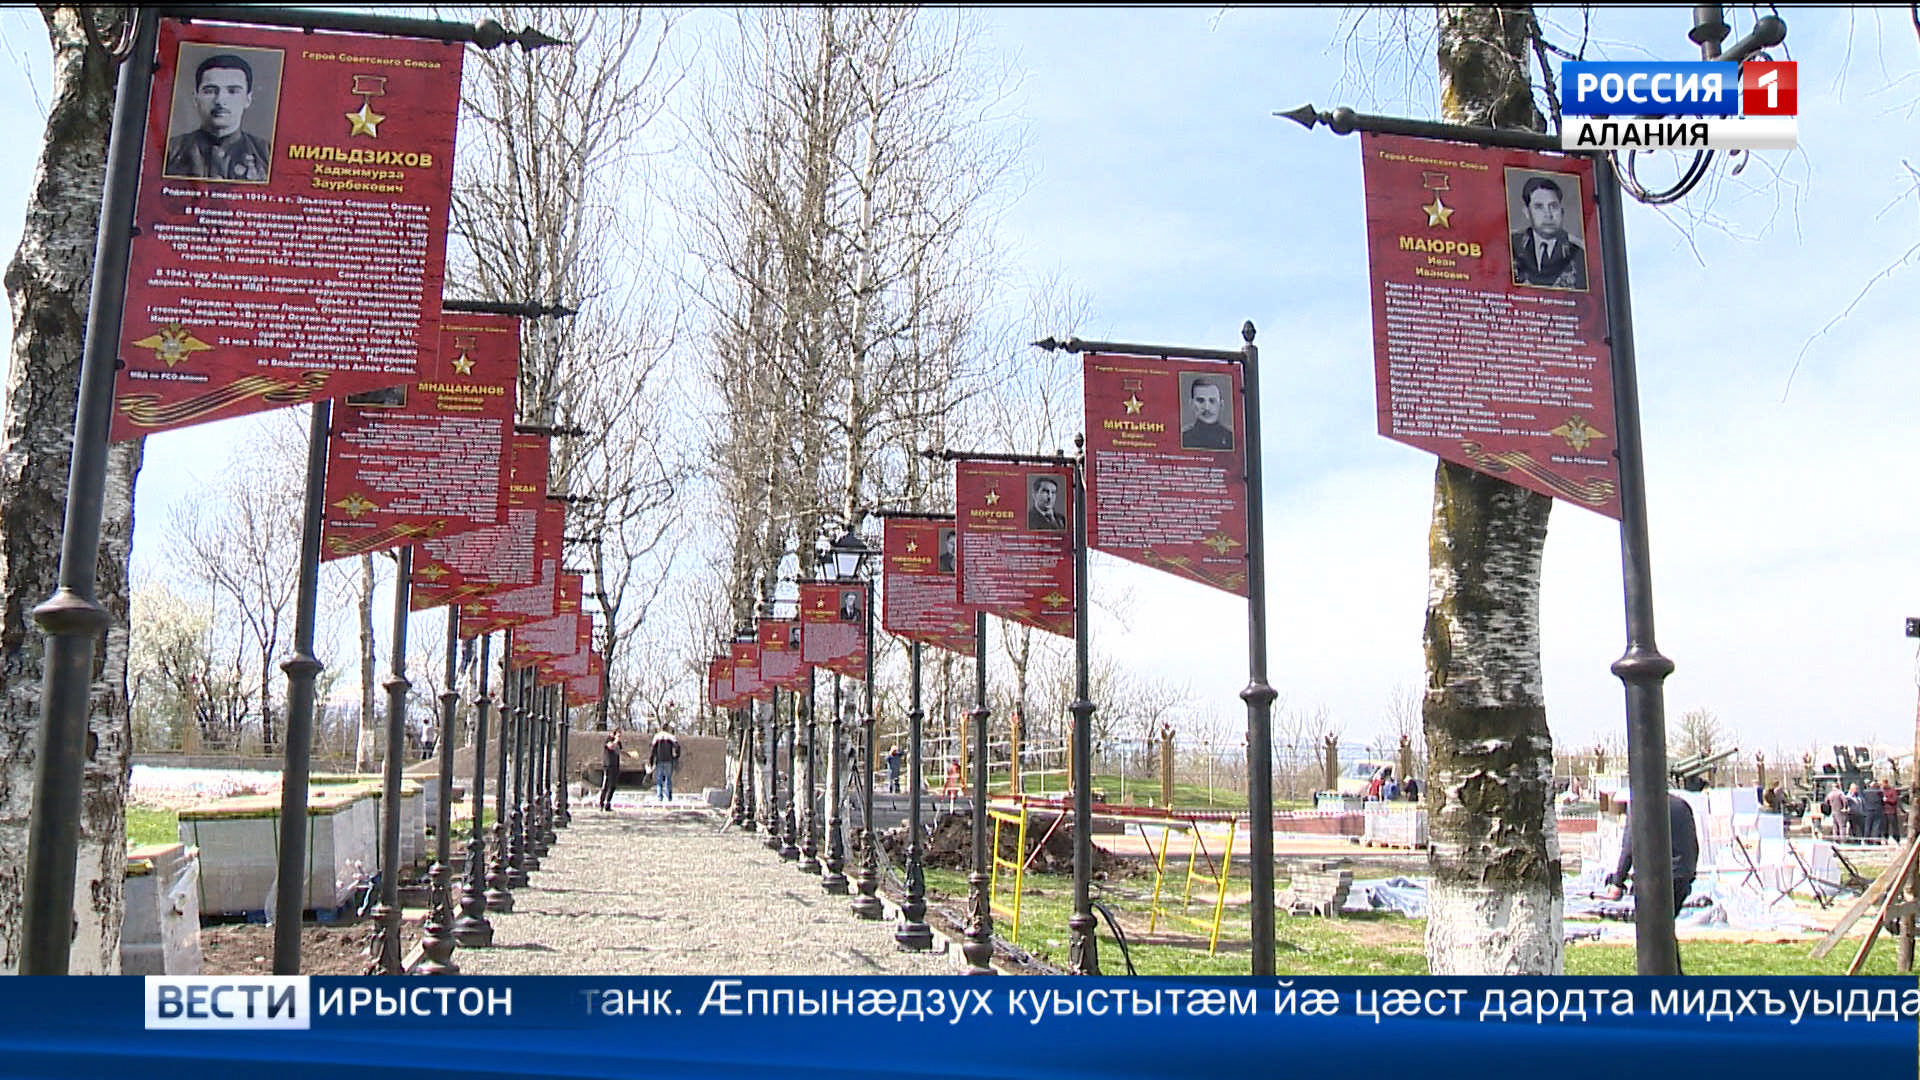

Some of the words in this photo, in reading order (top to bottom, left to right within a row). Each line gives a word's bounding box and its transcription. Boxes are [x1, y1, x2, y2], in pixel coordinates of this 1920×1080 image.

[302, 49, 336, 61] Герой
[338, 51, 401, 66] Советского
[404, 56, 441, 69] Союза
[289, 145, 433, 168] МИЛЬДЗИХОВ
[1379, 151, 1407, 161] Герой
[1408, 154, 1458, 167] Советского
[1459, 160, 1489, 171] Союза
[314, 164, 404, 180] Хаджимурза
[312, 179, 404, 195] Заурбекович
[1399, 236, 1482, 258] МАЮРОВ
[1427, 256, 1456, 267] Иван
[1415, 267, 1471, 281] Иванович
[418, 382, 505, 396] МНАЦАКАНОВ
[1103, 419, 1165, 433] МИТЬКИН
[969, 509, 1015, 520] МОРГОЕВ
